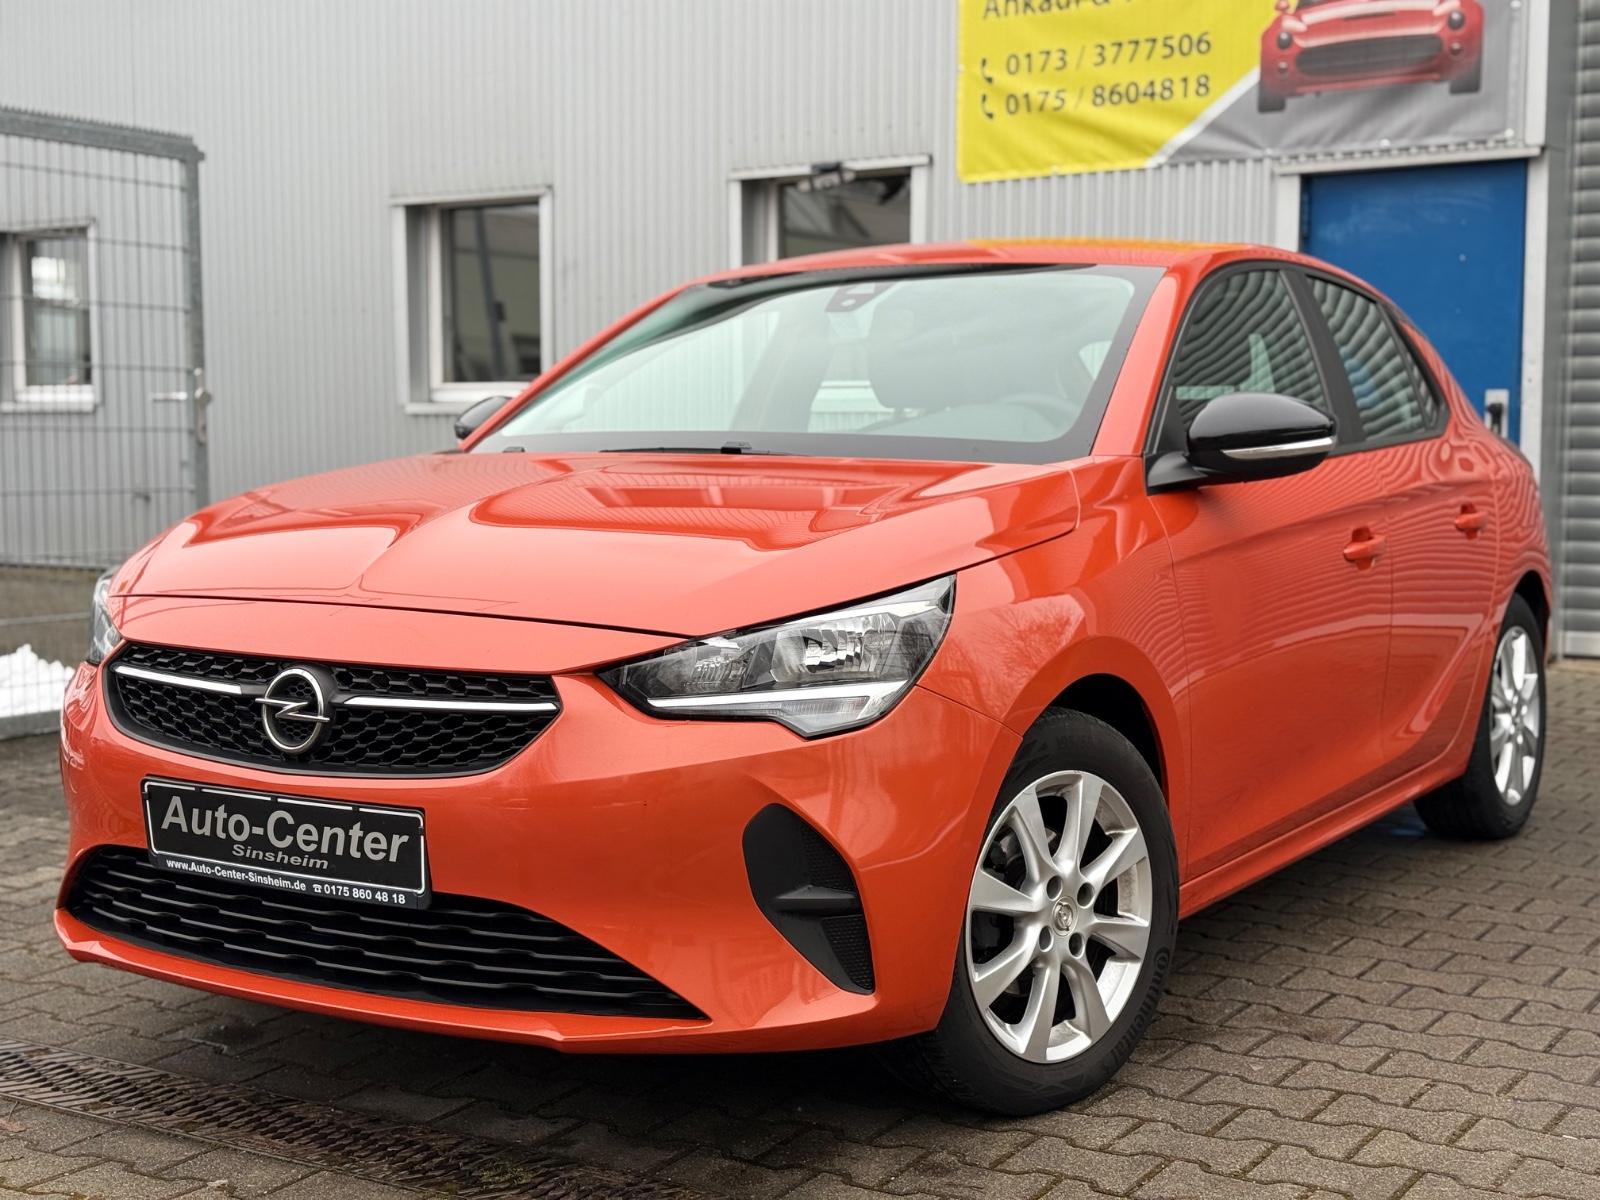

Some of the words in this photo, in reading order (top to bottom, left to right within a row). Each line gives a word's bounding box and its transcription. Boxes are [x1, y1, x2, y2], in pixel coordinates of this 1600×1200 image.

[1006, 48, 1067, 76] 0173
[1093, 32, 1212, 67] 3777506
[1005, 89, 1067, 115] 0175
[1091, 74, 1210, 108] 8604818
[161, 795, 409, 863] Auto-Center
[232, 843, 329, 870] Sinsheim
[166, 859, 307, 892] www.Auto-Center-Sinsheim.de
[324, 884, 350, 897] 0175
[352, 888, 373, 900] 860
[375, 891, 389, 903] 48
[392, 893, 406, 905] 18
